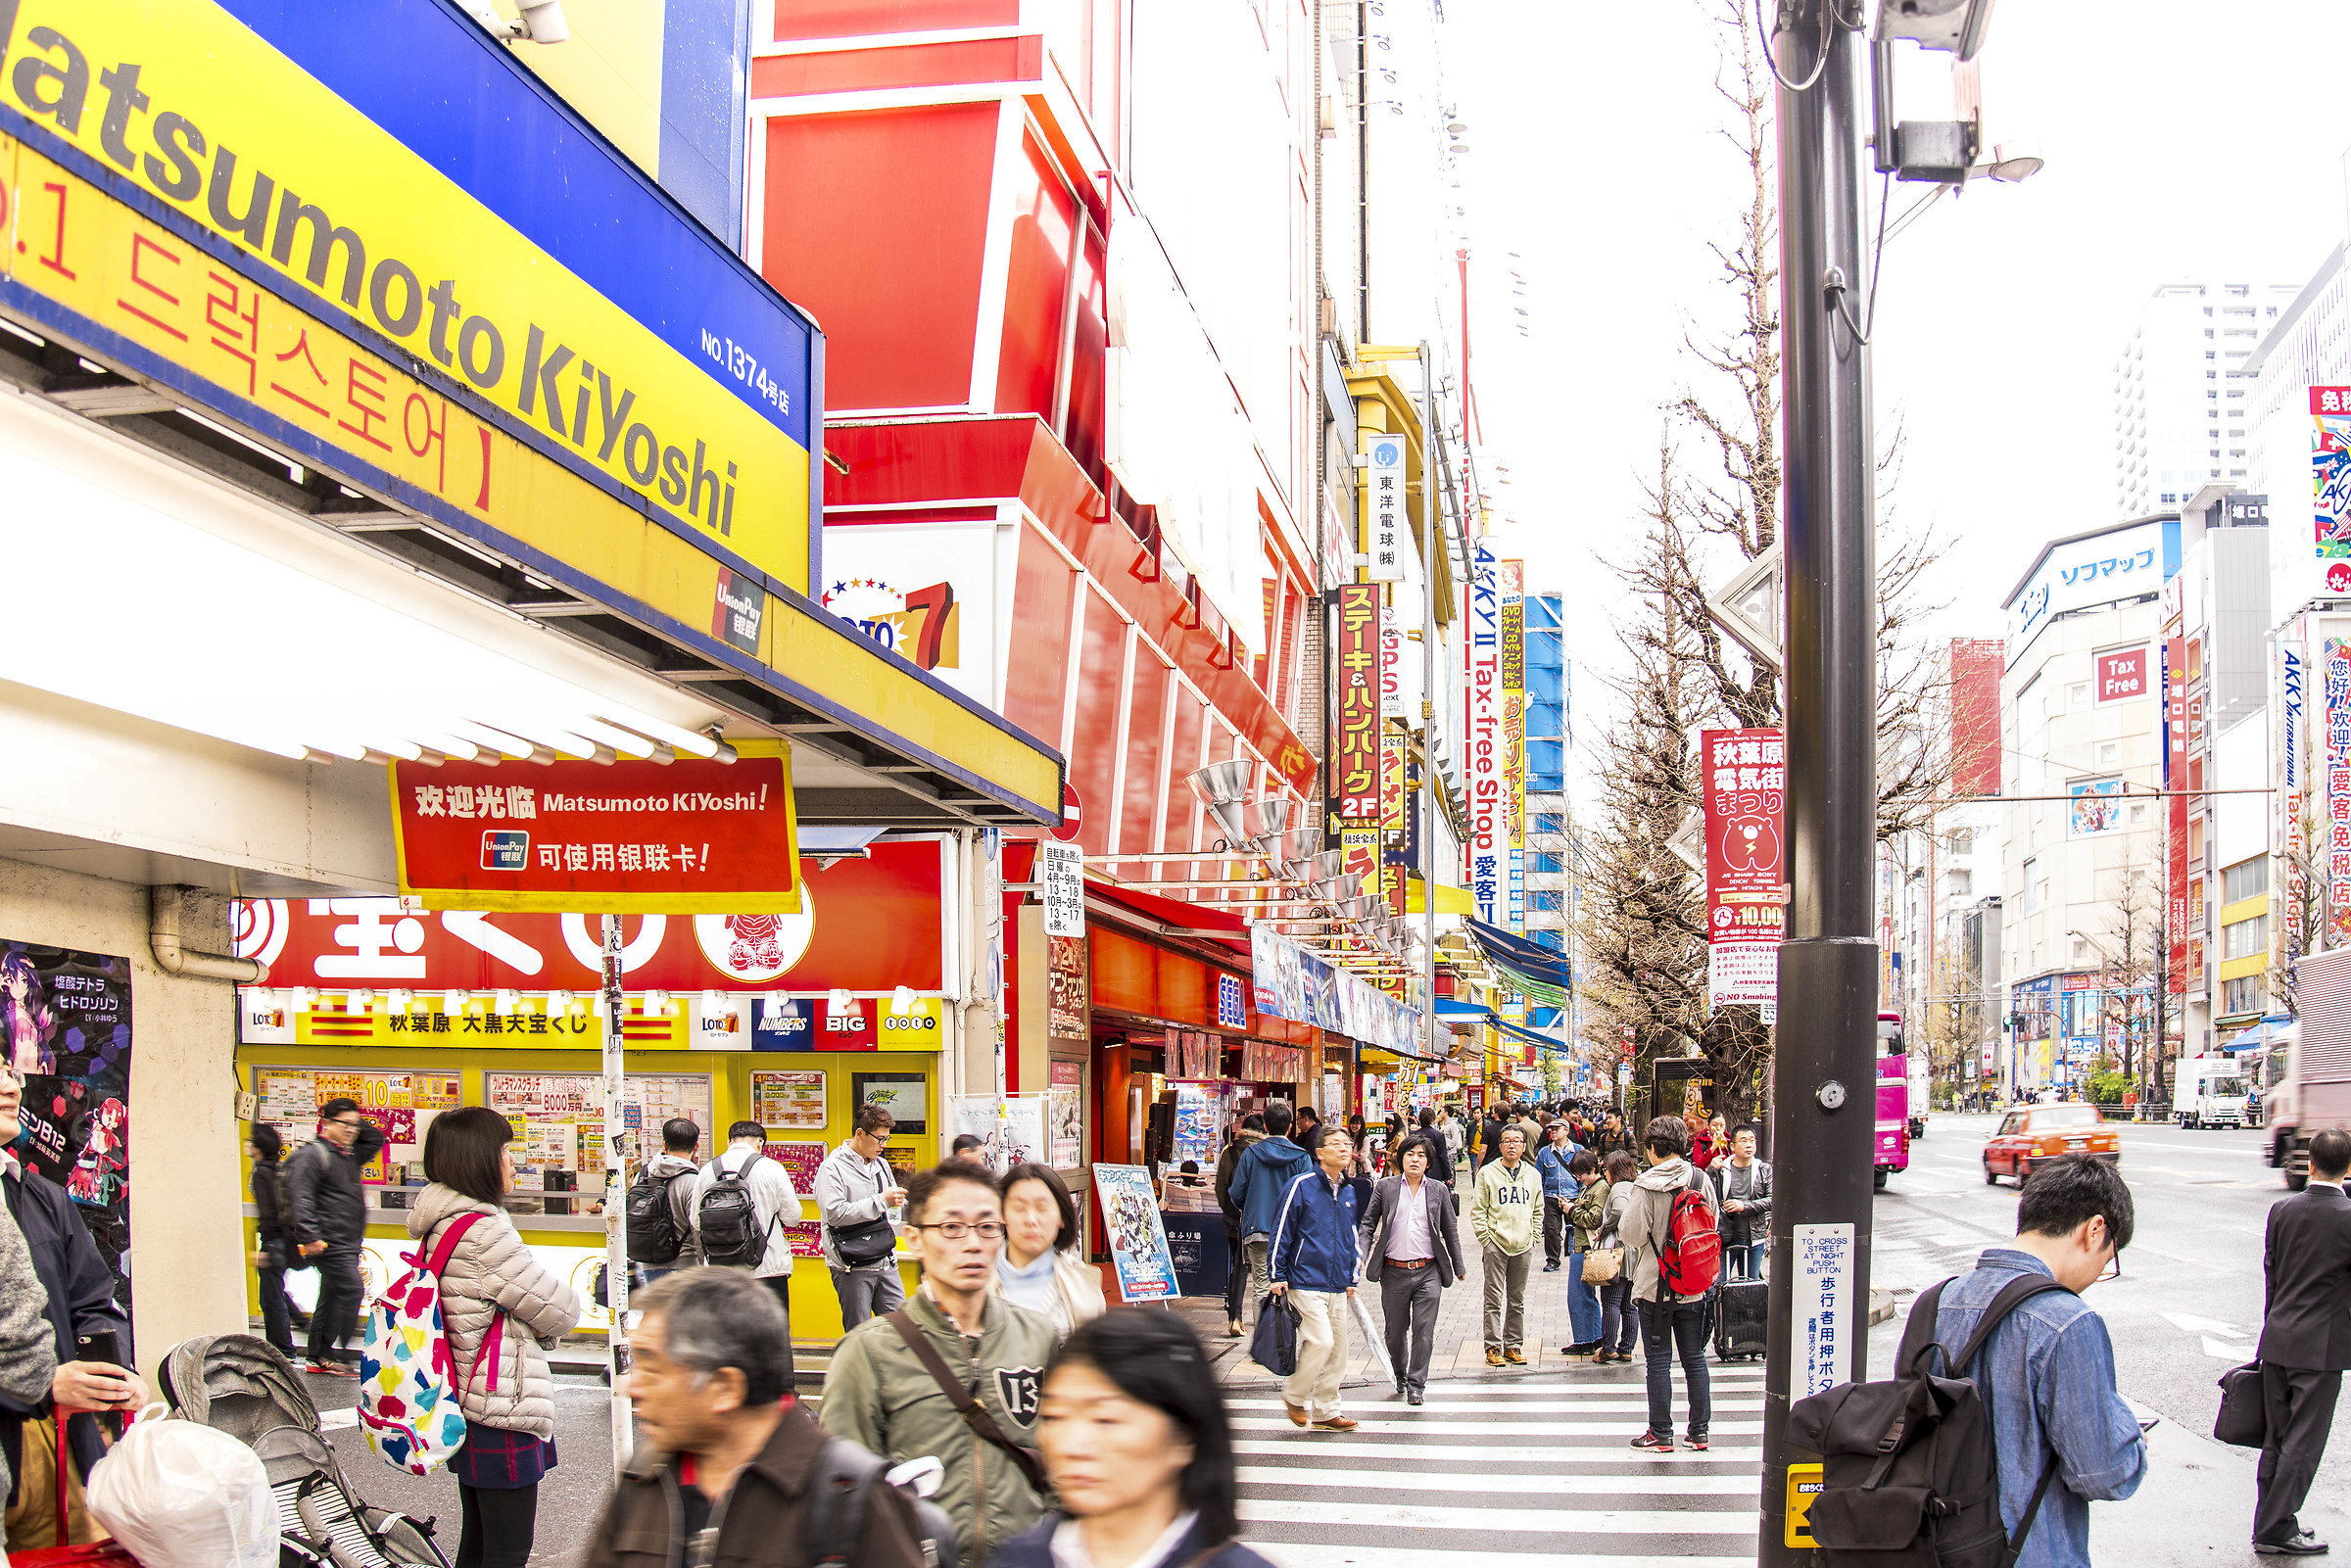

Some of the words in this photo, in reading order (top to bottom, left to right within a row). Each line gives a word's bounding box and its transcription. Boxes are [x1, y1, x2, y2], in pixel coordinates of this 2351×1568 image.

[0, 183, 76, 282] .1
[0, 0, 504, 394] atsumoto
[518, 323, 738, 538] KiYoshi
[2060, 546, 2155, 587] ソフマップ
[1474, 547, 1496, 628] AKKY
[717, 583, 761, 628] UnionPay
[1502, 594, 1521, 604] あなたの
[1503, 606, 1520, 616] DVD
[733, 613, 757, 642] 银联
[906, 582, 954, 670] 7
[1502, 616, 1521, 625] ブルーレイ
[1502, 625, 1521, 634] ゲーム
[1506, 634, 1518, 643] CD
[1503, 652, 1521, 661] アニメ
[1503, 661, 1520, 670] コミック
[2108, 658, 2136, 677] Tax
[1343, 587, 1373, 794] ステーキ&ハンバーグ
[2105, 677, 2139, 696] Free
[2284, 649, 2302, 716] AKKY
[1475, 653, 1498, 774] Tax-free
[1382, 736, 1403, 747] 家系
[2285, 699, 2294, 788] INTERNATIONAL
[1713, 741, 1784, 767] 秋葉原
[1713, 767, 1784, 791] 電気街
[414, 784, 537, 820] 欢迎光临
[543, 793, 669, 813] Matsumoto
[673, 784, 768, 812] KiYoshi!
[1342, 797, 1378, 817] 2F
[1715, 790, 1783, 816] まつり
[1476, 779, 1498, 850] Shop
[1343, 833, 1377, 844] 横浜家系
[1387, 830, 1402, 844] F
[485, 840, 525, 854] UnionPay
[1046, 847, 1080, 861] 自転車を除く
[501, 851, 521, 862] 银联
[537, 842, 710, 873] 可使用银联卡!
[1048, 860, 1071, 874] 日曜の
[1511, 862, 1522, 871] VD
[1511, 882, 1522, 891] VD
[1048, 920, 1068, 930] を除く
[55, 974, 105, 992] 塩酸テトラ
[60, 995, 119, 1011] ヒドロゾリン
[1219, 973, 1247, 1030] SEGA
[253, 1012, 271, 1026] LOTO
[389, 1012, 452, 1033] 秋葉原
[462, 1012, 588, 1035] 大黒天宝くじ
[702, 1017, 724, 1031] LOTO
[758, 1017, 807, 1031] NUMBERS
[825, 1017, 867, 1031] BIG
[884, 1016, 936, 1031] toto
[365, 1079, 388, 1107] 10
[544, 1094, 567, 1112] 8000
[567, 1102, 582, 1112] 万円
[18, 1105, 67, 1153] ミンB12
[1498, 1186, 1530, 1206] GAP
[1168, 1230, 1202, 1240] 傘ふり場
[1007, 1376, 1038, 1413] 13
